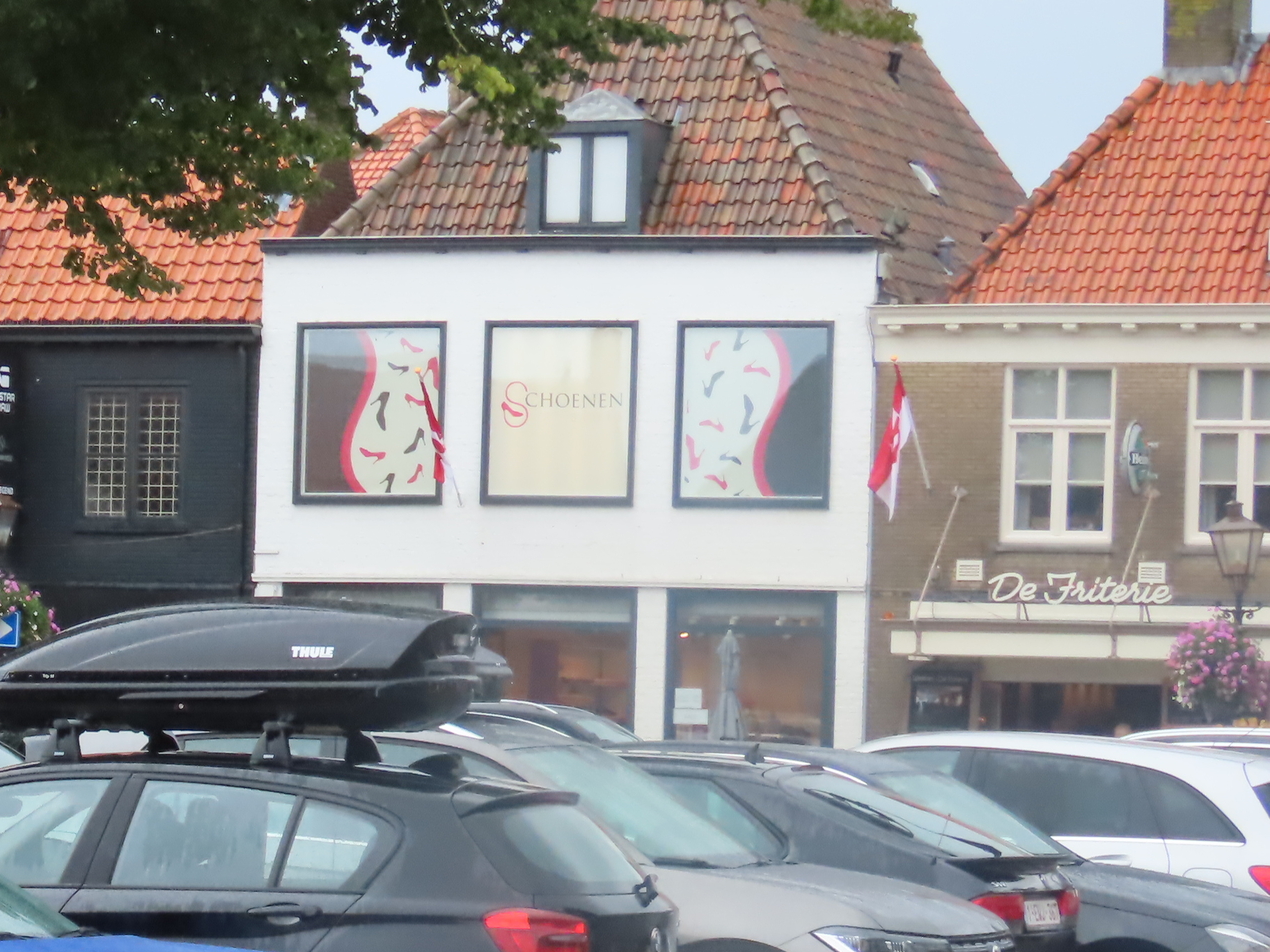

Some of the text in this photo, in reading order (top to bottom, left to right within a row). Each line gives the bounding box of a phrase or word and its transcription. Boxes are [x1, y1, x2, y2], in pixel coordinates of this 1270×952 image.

[988, 572, 1173, 605] De Friterie
[291, 645, 335, 659] THULE
